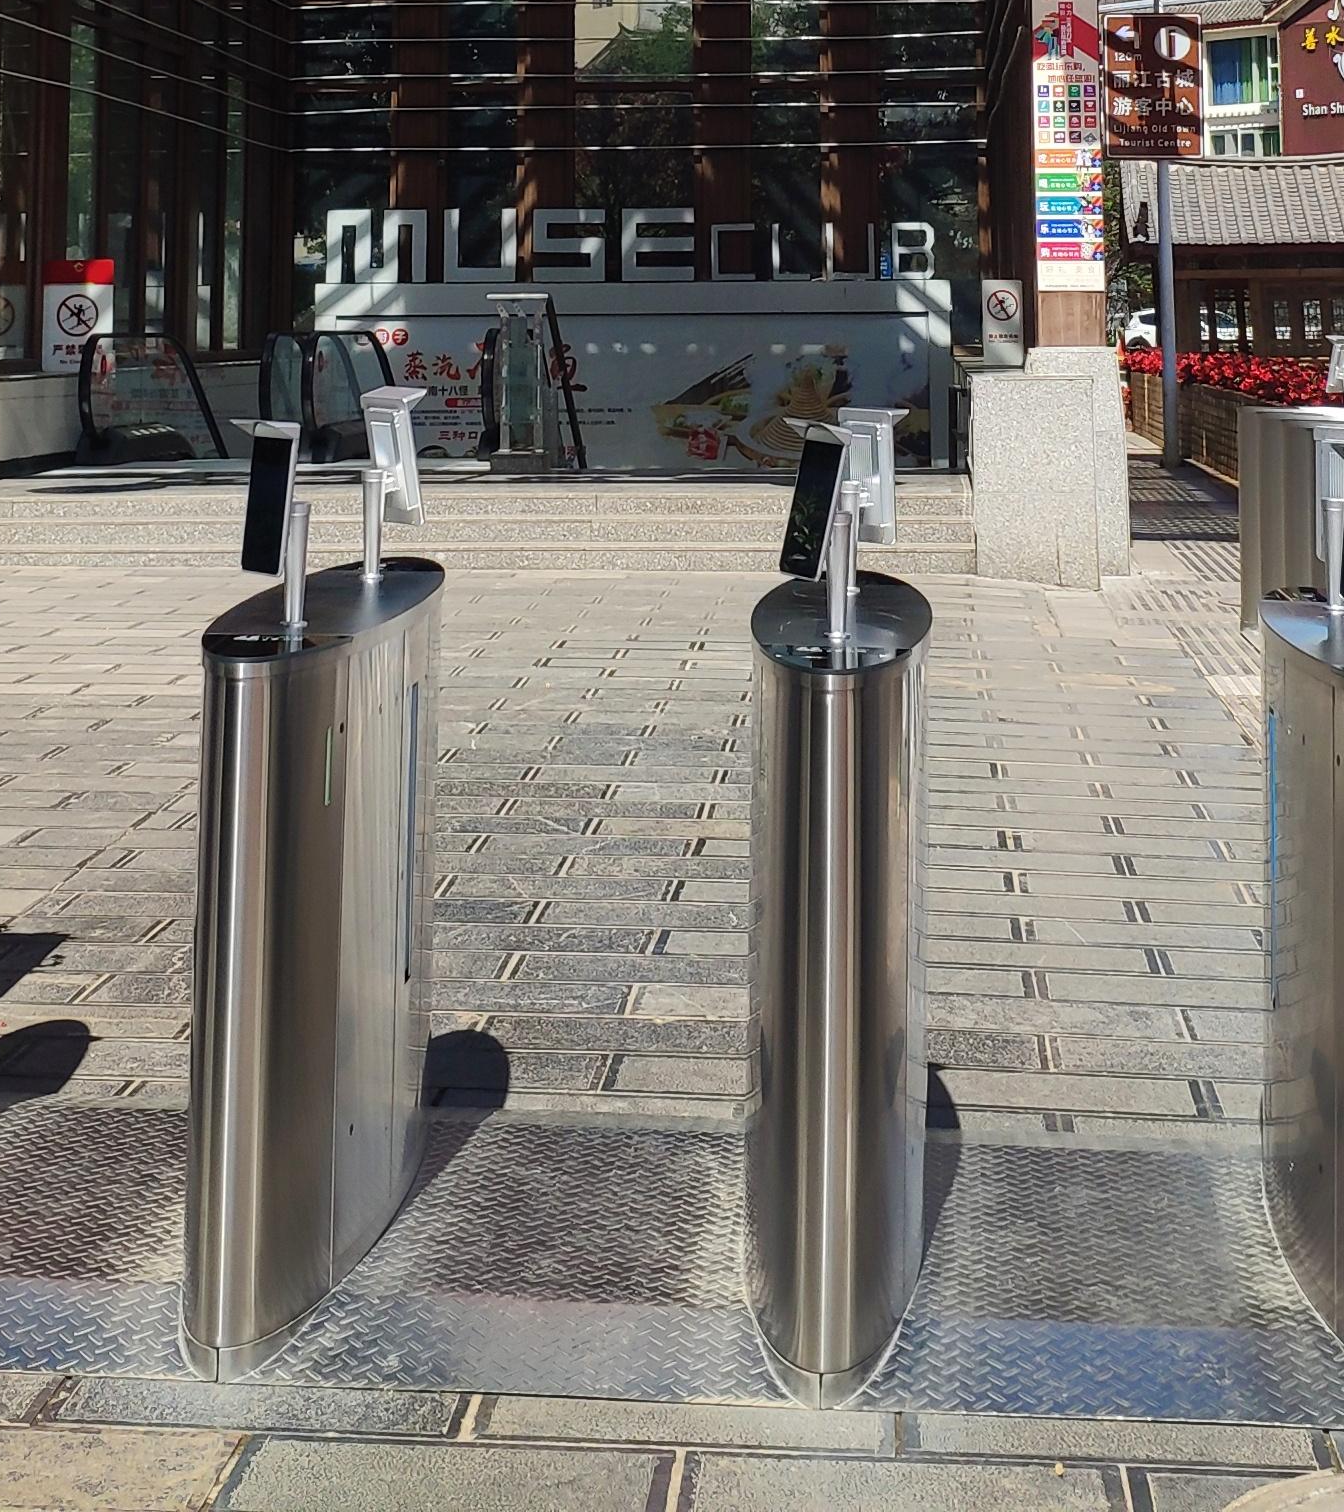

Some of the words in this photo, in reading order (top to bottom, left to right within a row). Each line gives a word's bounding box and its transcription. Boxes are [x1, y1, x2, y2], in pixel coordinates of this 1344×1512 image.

[1112, 69, 1195, 88] 丽江古城
[1113, 96, 1194, 116] 游客中心
[1302, 103, 1328, 116] Shan
[1113, 124, 1149, 135] Lijiang
[1151, 124, 1168, 133] Old
[1172, 124, 1197, 134] Town
[1119, 138, 1155, 148] Tourist
[1157, 138, 1193, 148] Centre
[325, 207, 695, 284] MUSE
[710, 221, 936, 281] CLUB
